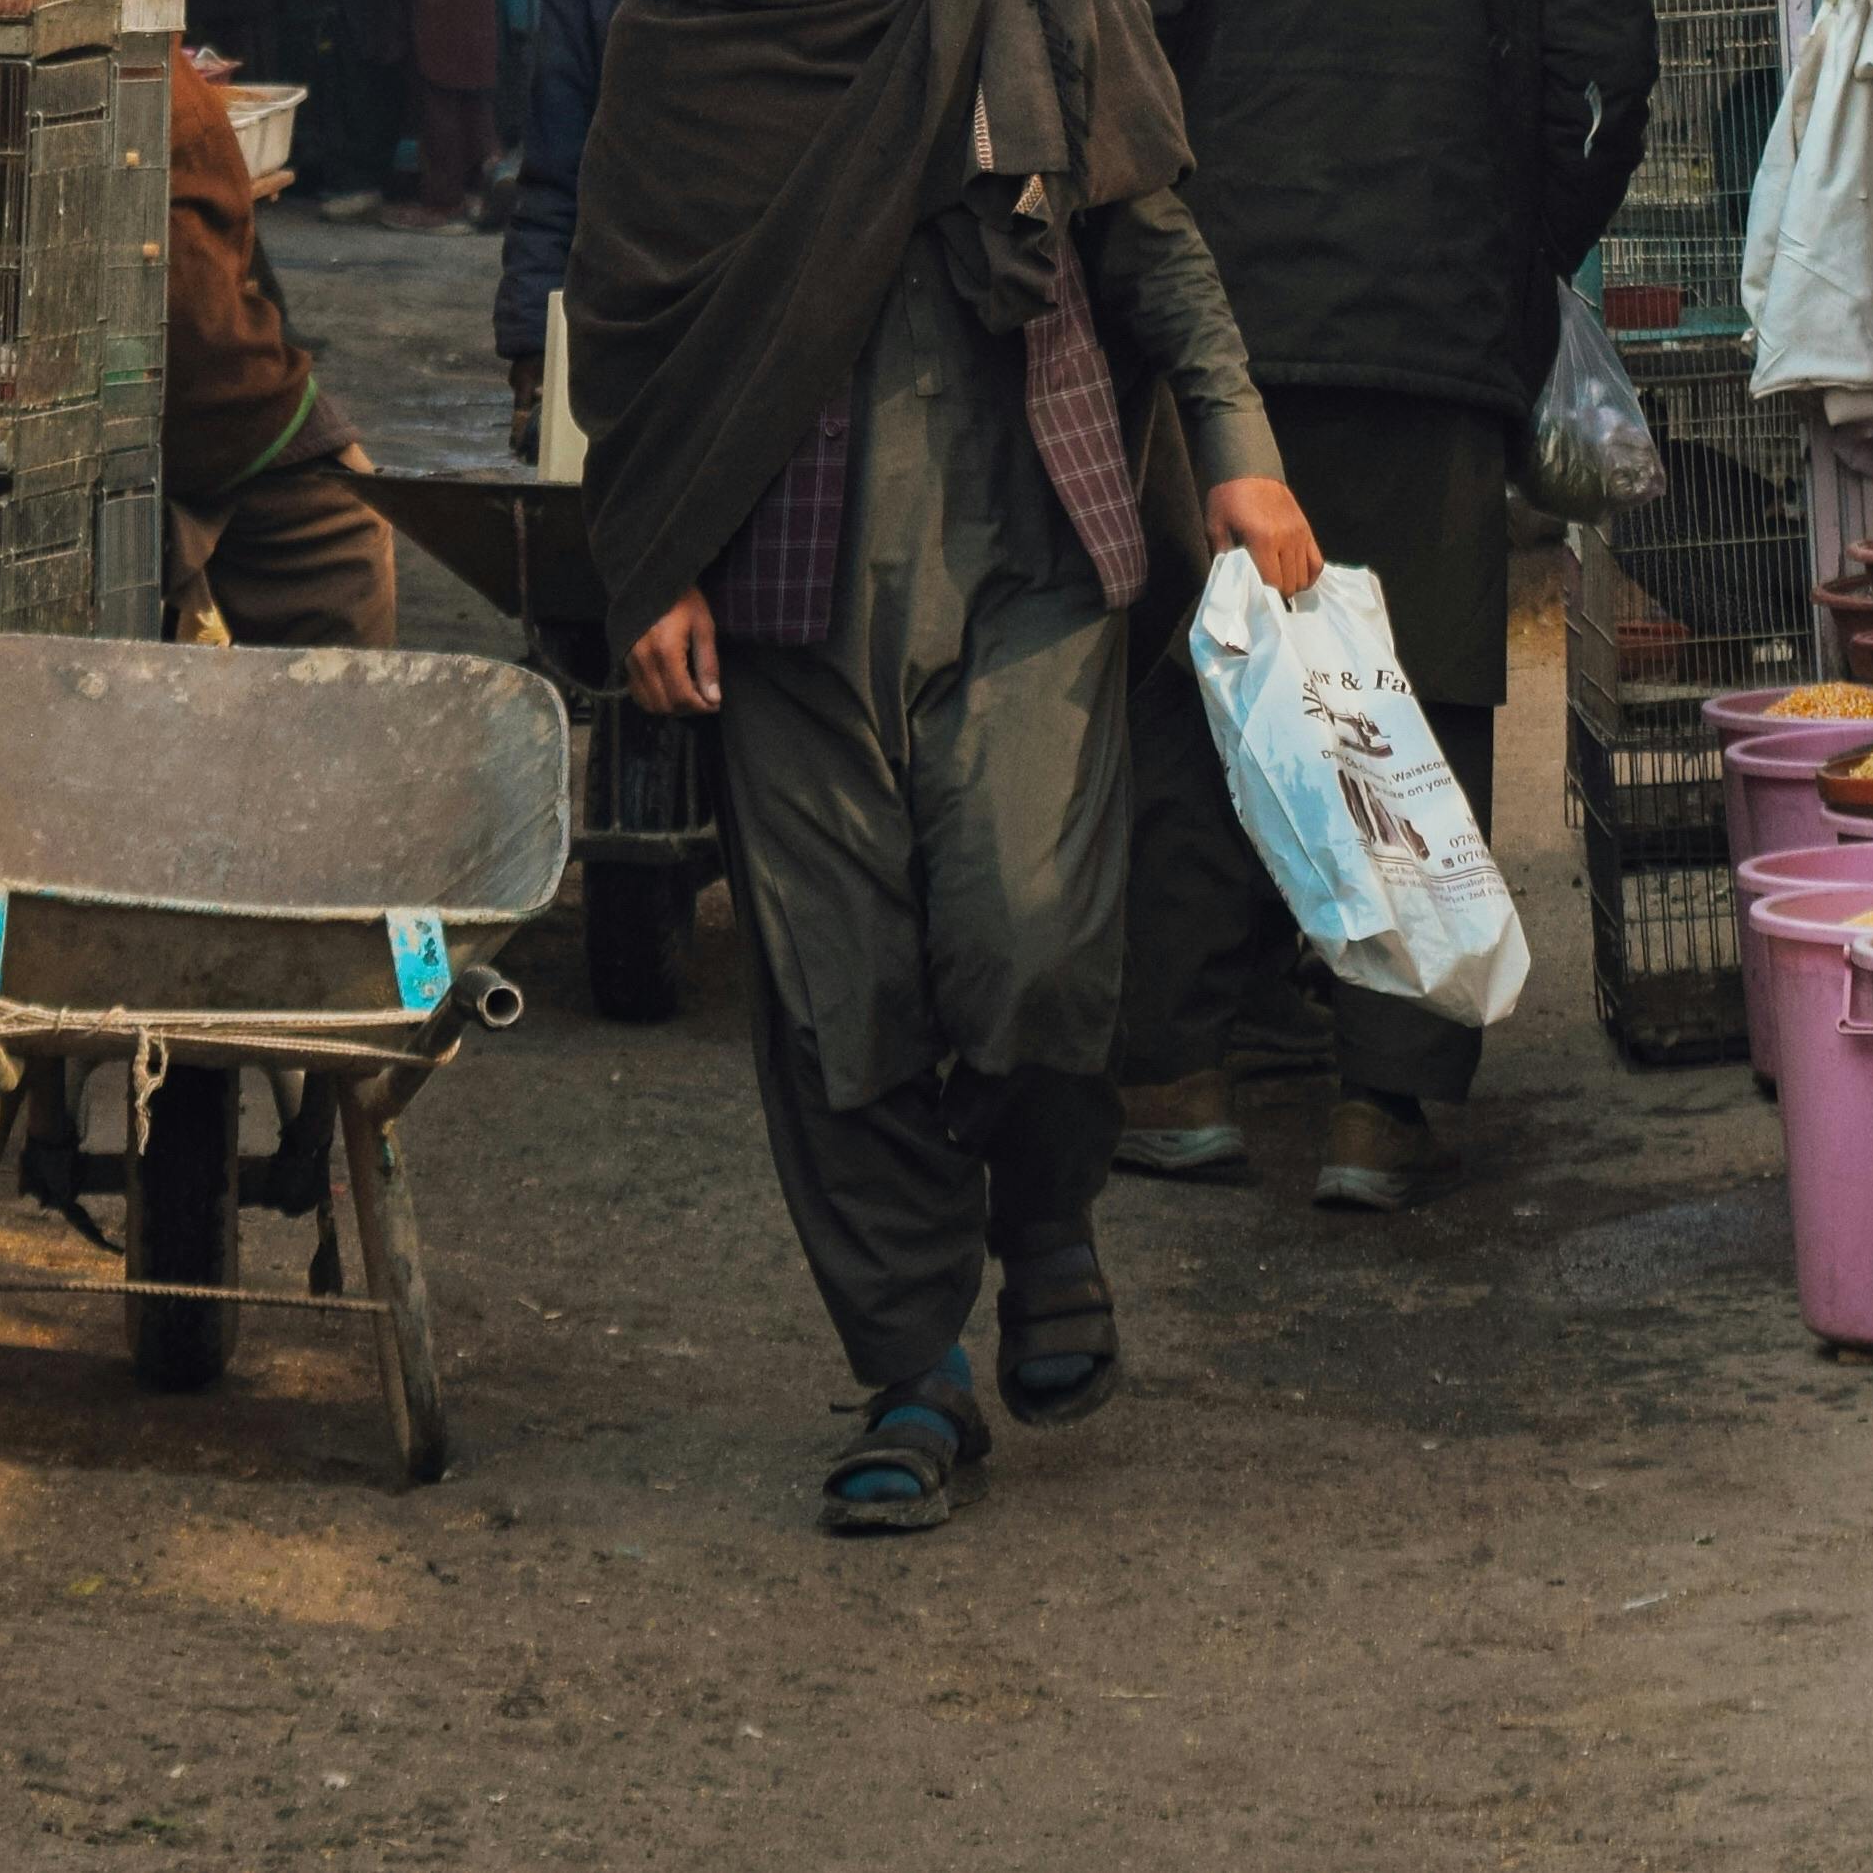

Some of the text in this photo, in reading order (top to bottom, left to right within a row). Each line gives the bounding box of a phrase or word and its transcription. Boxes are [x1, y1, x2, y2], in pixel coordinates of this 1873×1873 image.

[1340, 671, 1363, 691] &
[1373, 669, 1413, 696] Fa
[1407, 784, 1424, 798] on
[1425, 776, 1452, 793] your
